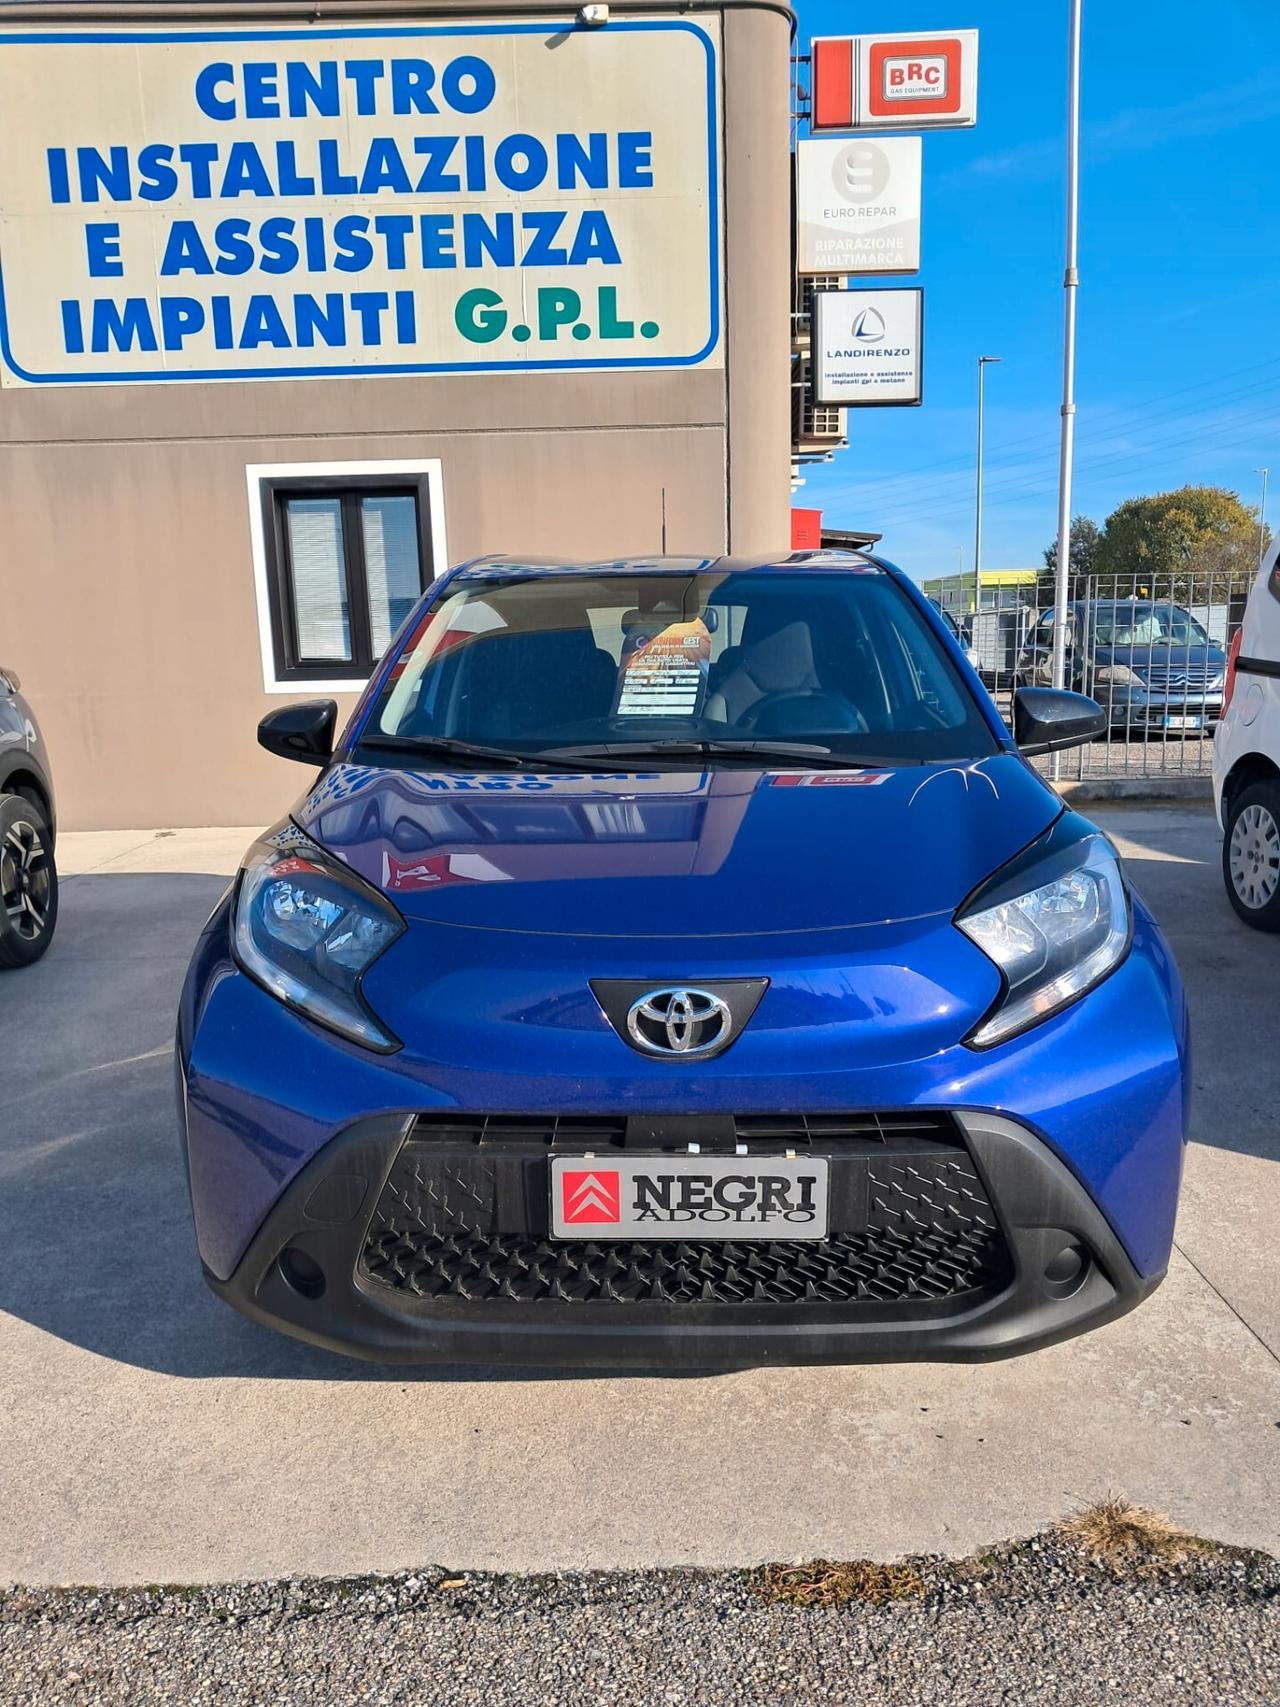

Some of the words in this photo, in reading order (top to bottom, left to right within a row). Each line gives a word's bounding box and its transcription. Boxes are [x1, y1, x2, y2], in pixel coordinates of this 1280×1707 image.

[890, 63, 940, 86] BRC
[195, 55, 496, 121] CENTRO
[46, 131, 654, 203] INSTALLAZIONE
[823, 208, 856, 219] EURO
[858, 206, 897, 217] REPAR
[85, 223, 124, 278] E
[160, 210, 622, 276] ASSISTENZA
[815, 237, 904, 252] RIPARAZIONE
[815, 252, 904, 267] MULTIMARCA
[60, 290, 417, 353] IMPIANTI
[454, 285, 660, 344] G.P.L.
[827, 348, 910, 359] LANDIRENZO
[832, 378, 860, 386] impianti
[632, 1175, 817, 1211] NEGRI
[632, 1208, 816, 1223] ADOLFO
